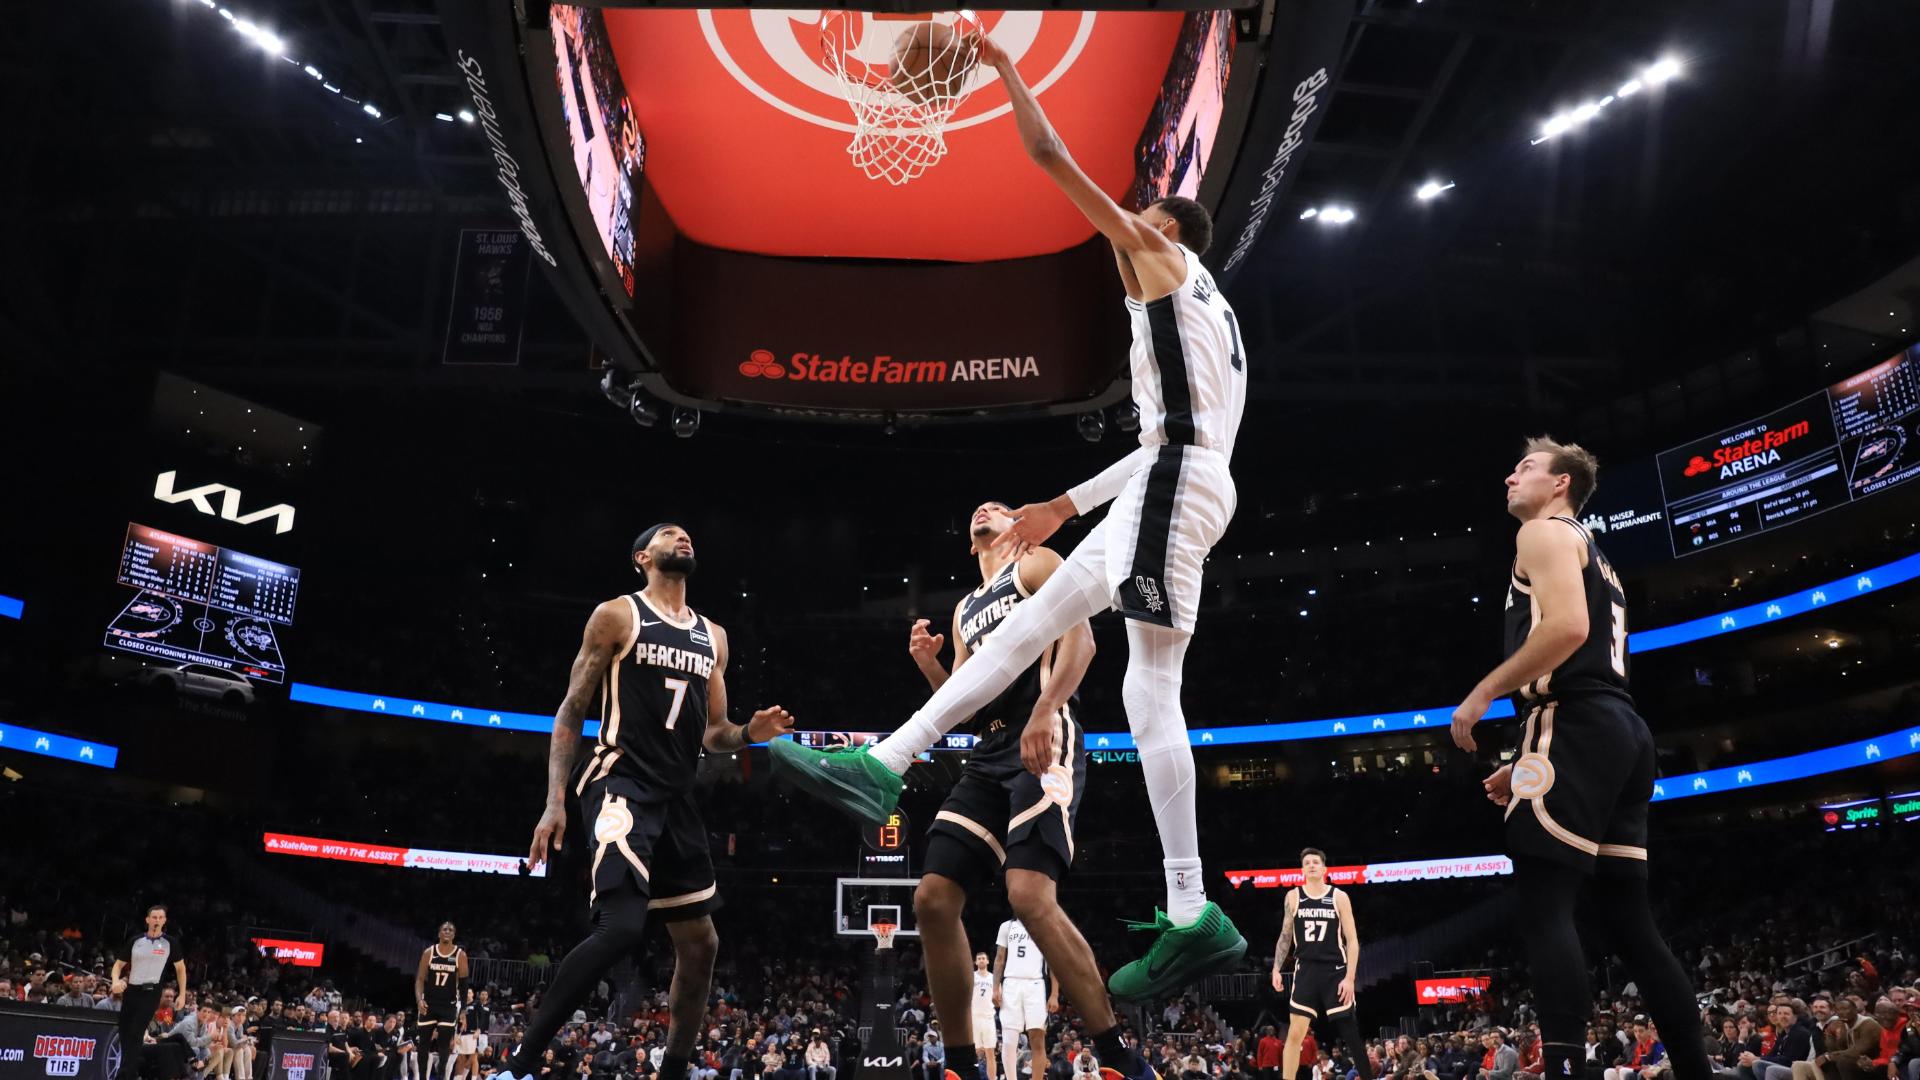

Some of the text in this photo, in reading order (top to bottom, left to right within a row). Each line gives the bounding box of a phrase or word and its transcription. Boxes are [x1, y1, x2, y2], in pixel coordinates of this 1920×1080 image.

[491, 233, 518, 243] LOUIS
[478, 244, 512, 255] HAWKS
[1224, 309, 1242, 373] 1
[951, 356, 1040, 382] ARENA
[1720, 424, 1767, 446] WELCOME TO
[1720, 449, 1781, 480] ARENA
[1722, 472, 1787, 499] AROUND THE LEAGUE
[1862, 465, 1920, 494] CLOSED CAPTIONIN
[1609, 510, 1635, 522] KAISER
[1611, 512, 1663, 531] PERMANENTE
[1729, 525, 1742, 533] 112
[131, 563, 158, 575] Okongwu
[1610, 601, 1628, 678] 3
[119, 639, 233, 670] CLOSED CAPTIONING PRESENTED BY
[635, 642, 715, 680] PEACHTREE
[664, 677, 689, 730] 7
[864, 735, 879, 746] 72
[946, 737, 968, 748] 105
[1846, 807, 1879, 822] Sprite
[880, 826, 898, 847] 13
[322, 845, 347, 856] WITH
[349, 848, 367, 858] THE
[367, 850, 400, 861] ASSIST
[875, 855, 904, 863] TISSOT
[467, 859, 491, 868] WITH
[493, 861, 509, 870] THE
[1427, 864, 1452, 875] WITH
[1455, 863, 1472, 873] THE
[1475, 861, 1508, 871] ASSIST
[1280, 873, 1305, 883] WITH
[1297, 908, 1336, 919] PEACHTREE
[1304, 920, 1328, 942] 27
[1017, 946, 1026, 958] 5
[435, 972, 449, 986] 17
[980, 989, 986, 997] 7
[33, 1035, 96, 1060] DISCOUNT
[0, 1048, 24, 1062] .com
[281, 1053, 315, 1070] DISCOUNT
[50, 1060, 76, 1073] TIRE
[290, 1070, 304, 1080] TIRE
